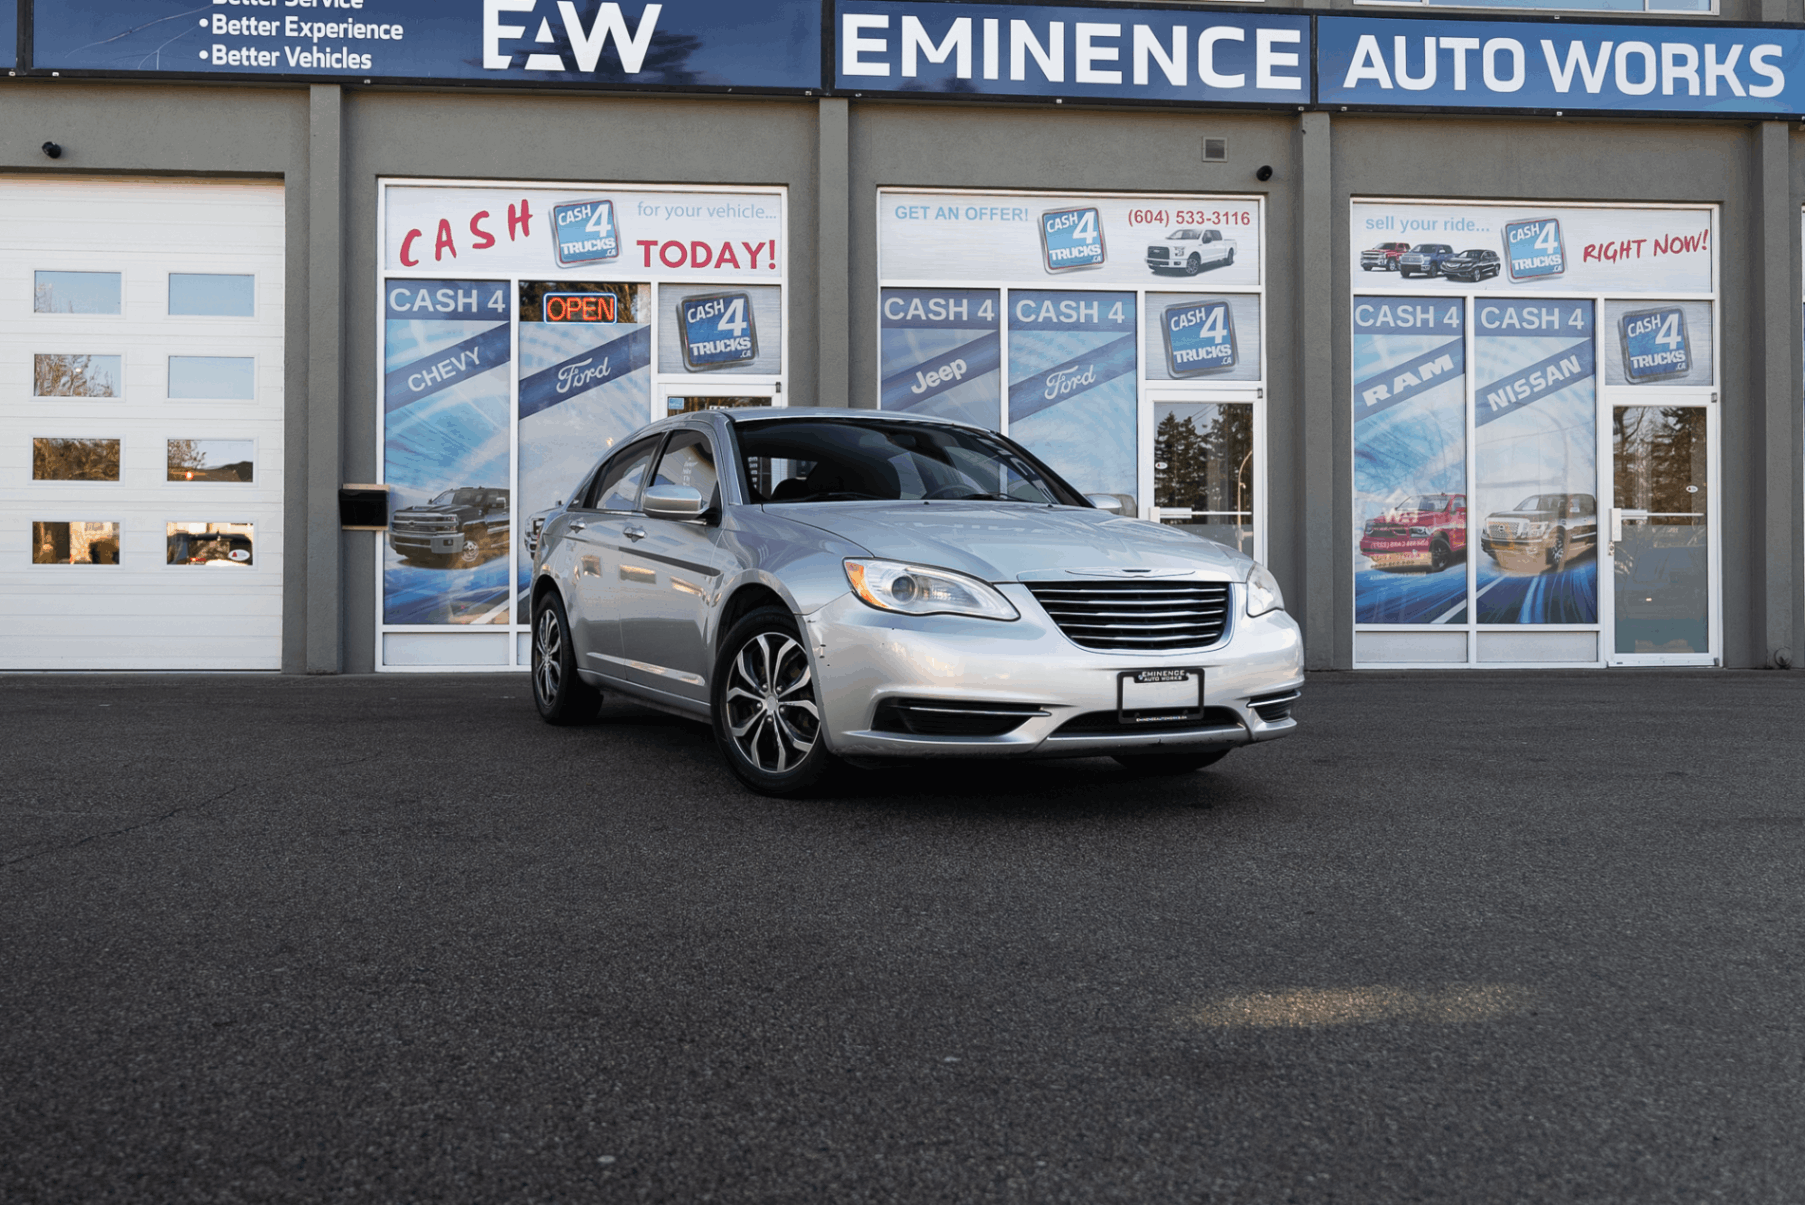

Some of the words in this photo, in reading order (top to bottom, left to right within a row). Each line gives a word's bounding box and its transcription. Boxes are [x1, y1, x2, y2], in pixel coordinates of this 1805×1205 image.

[212, 13, 280, 36] Better
[285, 16, 404, 43] Experience
[212, 44, 280, 67] Better
[284, 46, 373, 69] Vehicles
[842, 13, 1302, 90] EMINENCE
[1343, 34, 1526, 93] AUTO
[1540, 39, 1786, 98] WORKS
[558, 204, 592, 226] CASH
[585, 204, 612, 237] 4
[637, 201, 661, 217] for
[664, 204, 702, 220] your
[706, 203, 777, 219] vehicle...
[895, 205, 930, 219] GET
[935, 206, 959, 220] AN
[965, 206, 1028, 221] OFFER!
[1128, 209, 1170, 227] (604)
[1176, 210, 1250, 226] 533-3116
[1365, 216, 1394, 230] sell
[1400, 218, 1438, 233] your
[1443, 217, 1490, 232] ride...
[400, 198, 534, 267] CASH
[1046, 212, 1078, 233] CASH
[1072, 211, 1098, 244] 4
[1509, 222, 1540, 243] CASH
[1534, 222, 1558, 254] 4
[561, 237, 616, 256] TRUCKS
[636, 239, 776, 270] TODAY!
[1049, 244, 1101, 261] TRUCKS
[1583, 239, 1647, 264] RIGHT
[1653, 229, 1709, 257] NOW!
[1512, 254, 1562, 271] TRUCKS
[389, 288, 478, 313] CASH
[487, 290, 506, 313] 4
[547, 296, 615, 321] OPEN
[884, 297, 968, 321] CASH
[977, 299, 995, 321] 4
[1016, 299, 1099, 323] CASH
[1108, 301, 1125, 323] 4
[687, 299, 725, 323] CASH
[717, 298, 747, 337] 4
[1170, 307, 1206, 331] CASH
[1199, 306, 1228, 344] 4
[1355, 304, 1435, 328] CASH
[1443, 306, 1460, 328] 4
[1480, 306, 1560, 330] CASH
[1568, 308, 1585, 330] 4
[690, 336, 752, 356] TRUCKS
[1627, 314, 1661, 338] CASH
[1655, 313, 1682, 350] 4
[1173, 344, 1232, 363] TRUCKS
[1630, 350, 1686, 369] TRUCKS
[407, 347, 482, 392] CHEVY
[556, 357, 611, 394] Ford
[911, 358, 967, 394] Jeep
[1044, 364, 1096, 400] Ford
[1362, 353, 1455, 407] RAM
[1486, 354, 1582, 412] NISSAN
